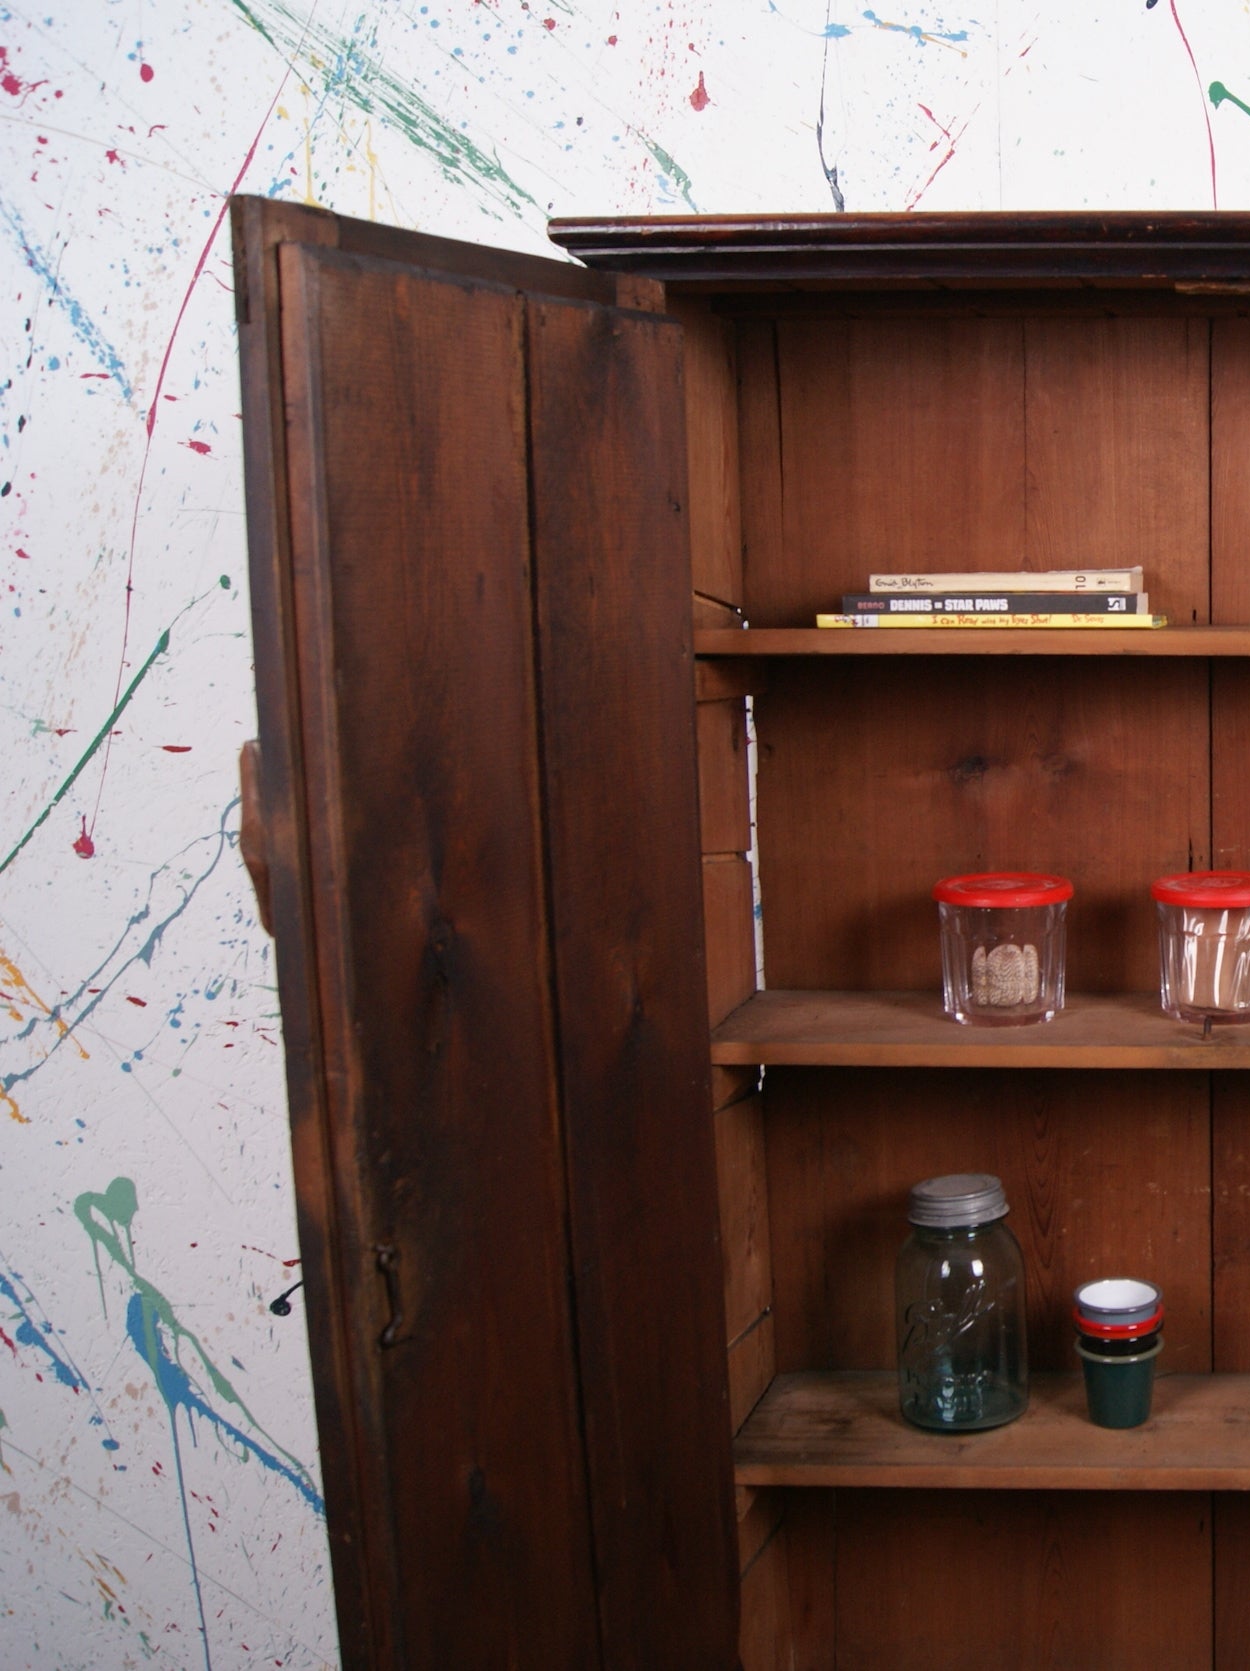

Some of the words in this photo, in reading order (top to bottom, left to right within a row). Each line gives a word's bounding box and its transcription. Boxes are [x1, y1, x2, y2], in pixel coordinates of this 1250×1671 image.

[901, 577, 933, 589] Blyton
[889, 599, 932, 612] DENNIS
[944, 599, 974, 612] STAR
[975, 598, 1009, 611] PAWS
